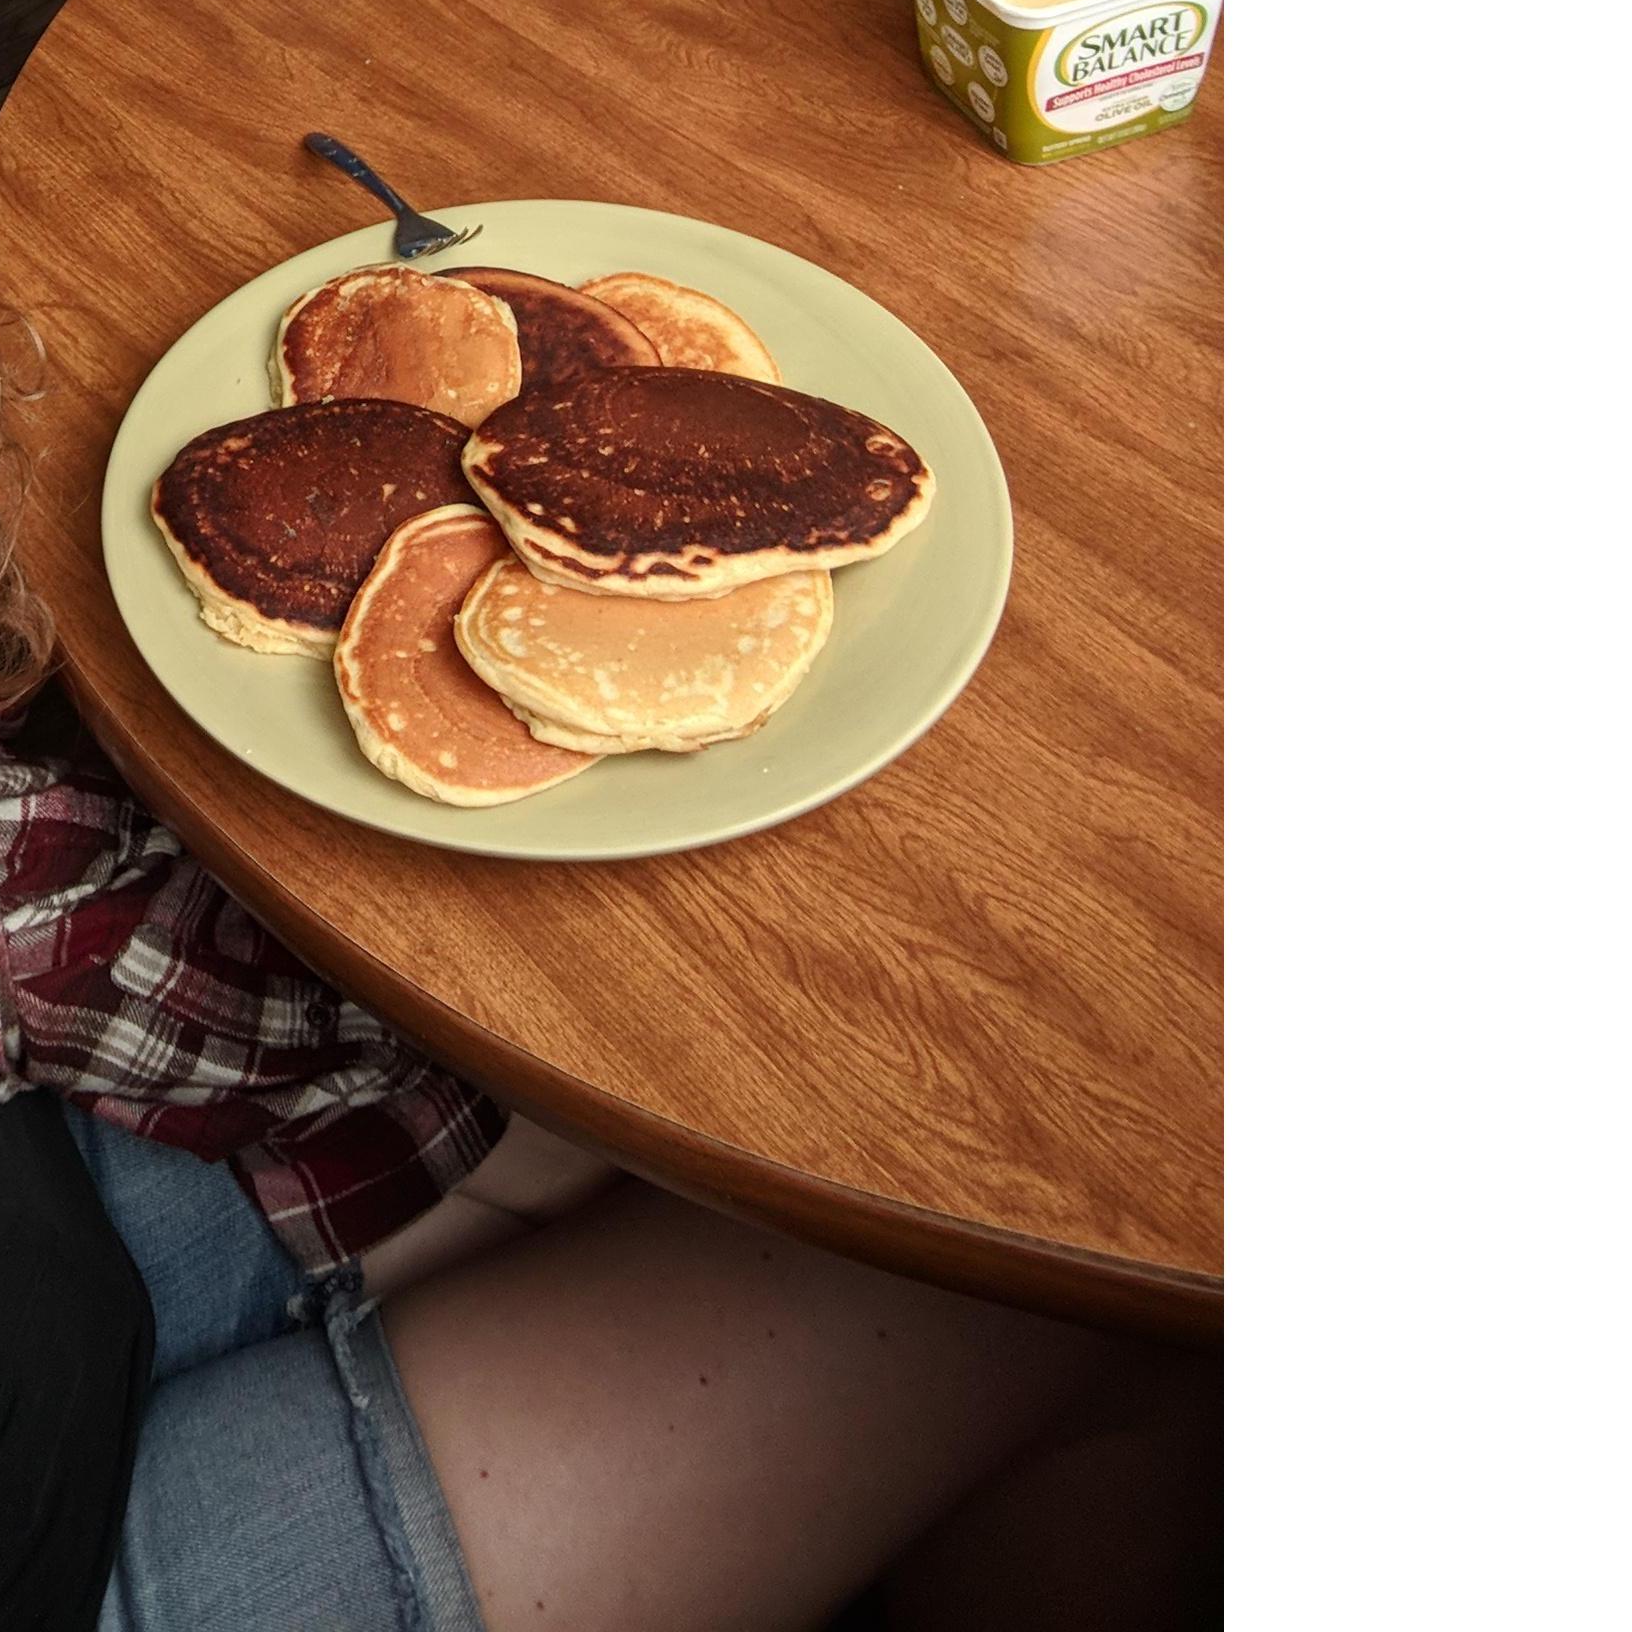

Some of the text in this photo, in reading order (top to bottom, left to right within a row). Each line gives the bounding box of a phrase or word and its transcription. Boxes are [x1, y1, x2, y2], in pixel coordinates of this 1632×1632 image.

[1072, 29, 1193, 82] BALANCE
[1078, 9, 1190, 60] SMART
[1052, 86, 1093, 109] Supports
[1094, 76, 1128, 94] Healthy
[1129, 63, 1175, 84] Cholesterol
[1095, 100, 1153, 122] OLIVE OIL
